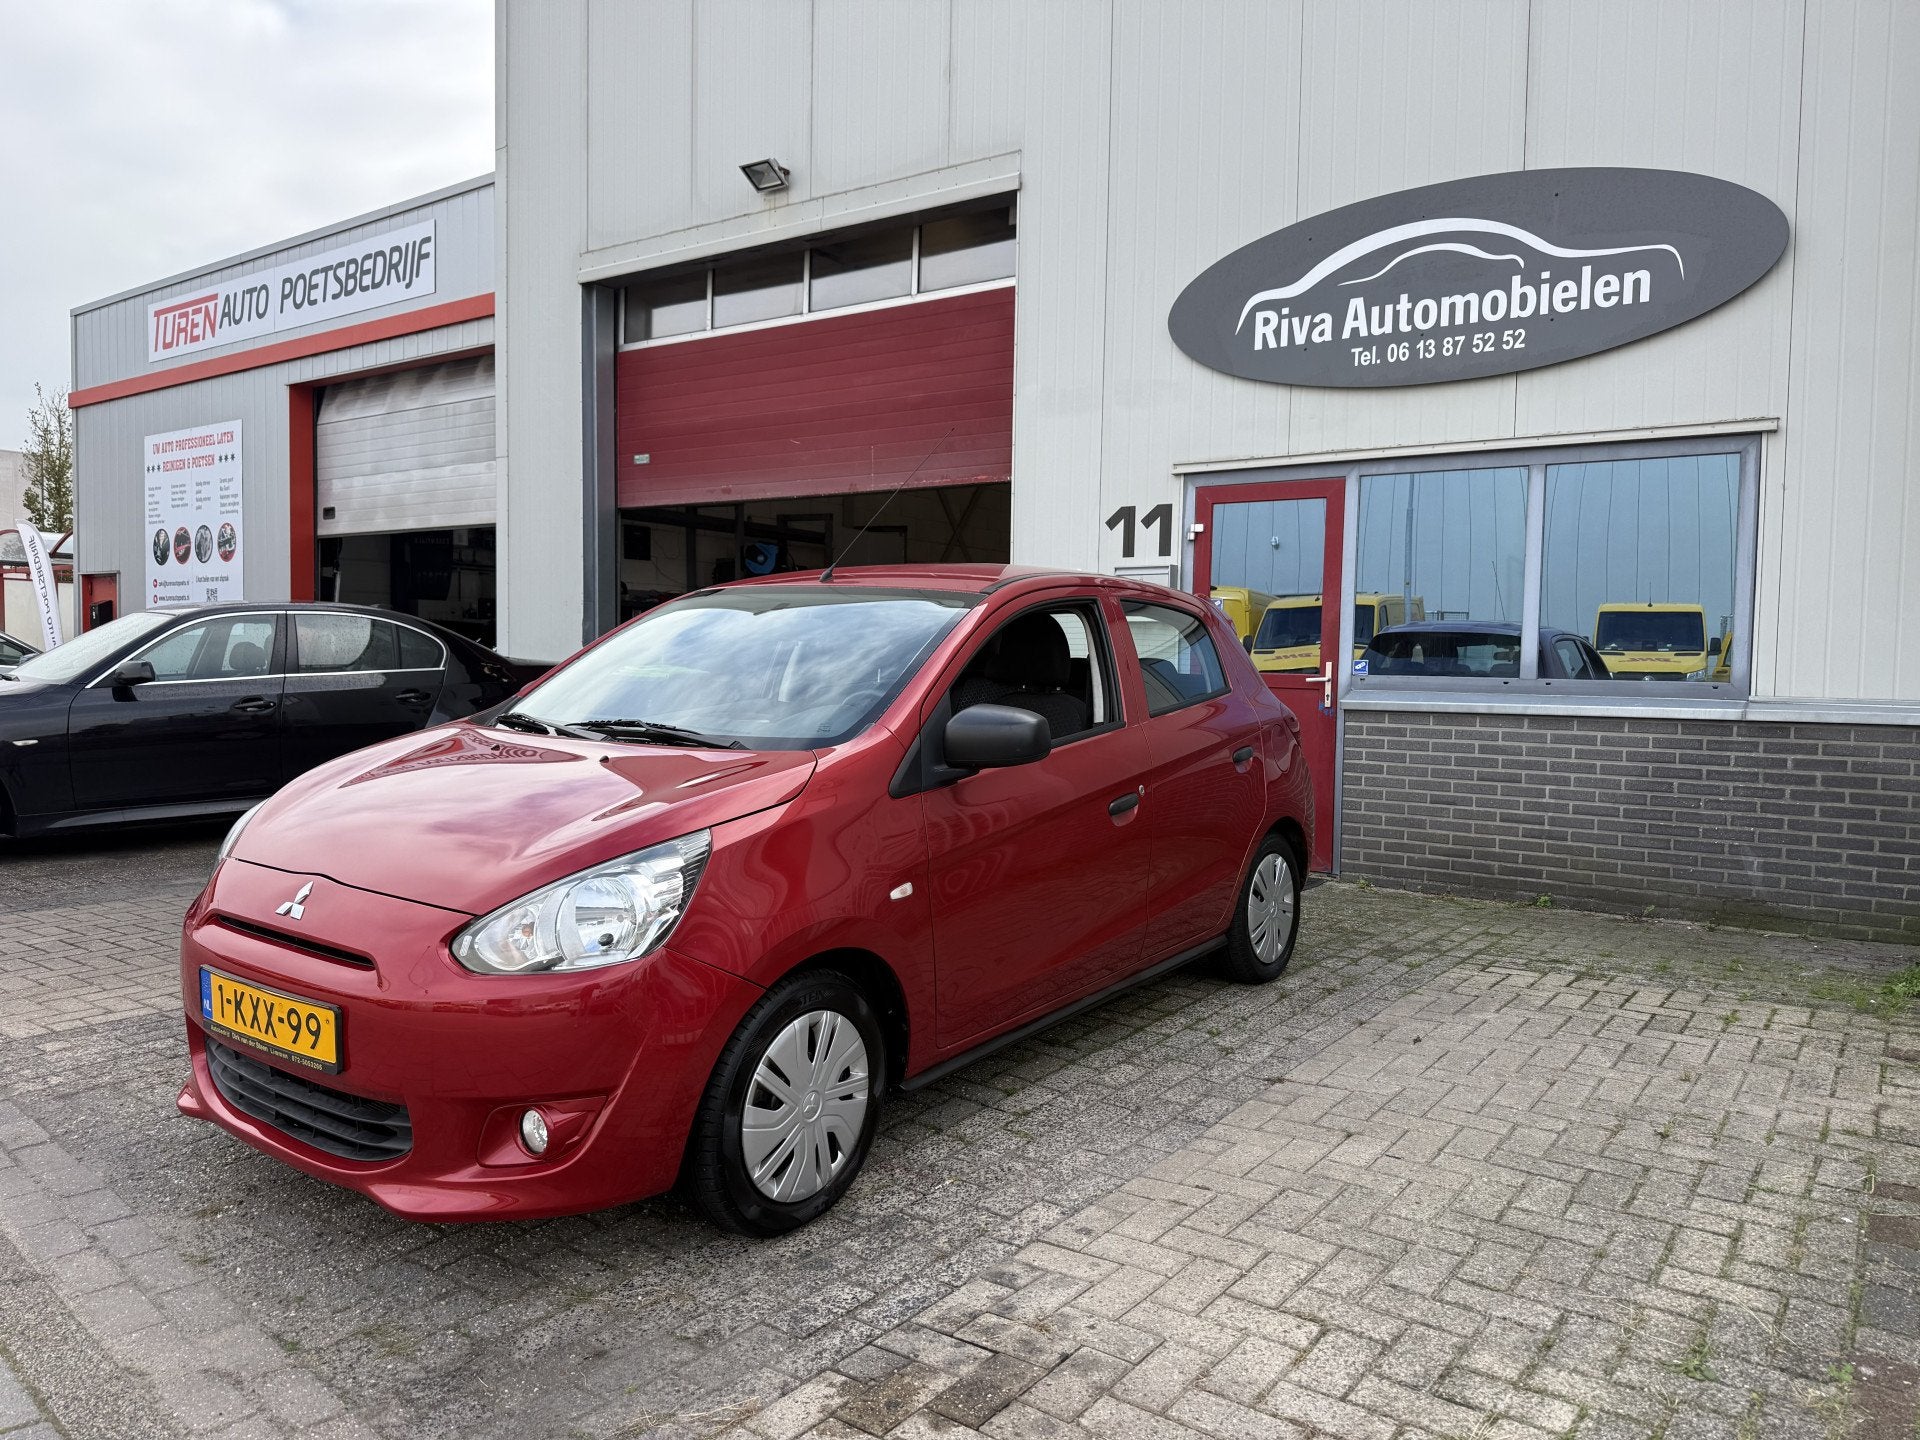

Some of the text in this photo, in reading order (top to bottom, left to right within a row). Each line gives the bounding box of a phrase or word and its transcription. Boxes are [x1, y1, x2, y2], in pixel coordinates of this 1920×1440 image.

[154, 235, 432, 352] TUREN AUTO POETSBEDRIJF
[1254, 265, 1651, 351] Riva Automobielen
[1351, 328, 1526, 367] Tel. 06 13 87 52 52
[175, 434, 216, 452] PROFESSIONEEL
[217, 430, 234, 445] LATEN
[192, 453, 215, 468] POETSEN
[1105, 503, 1173, 558] 11
[203, 998, 212, 1011] NL
[218, 984, 321, 1050] 1-KXX-99
